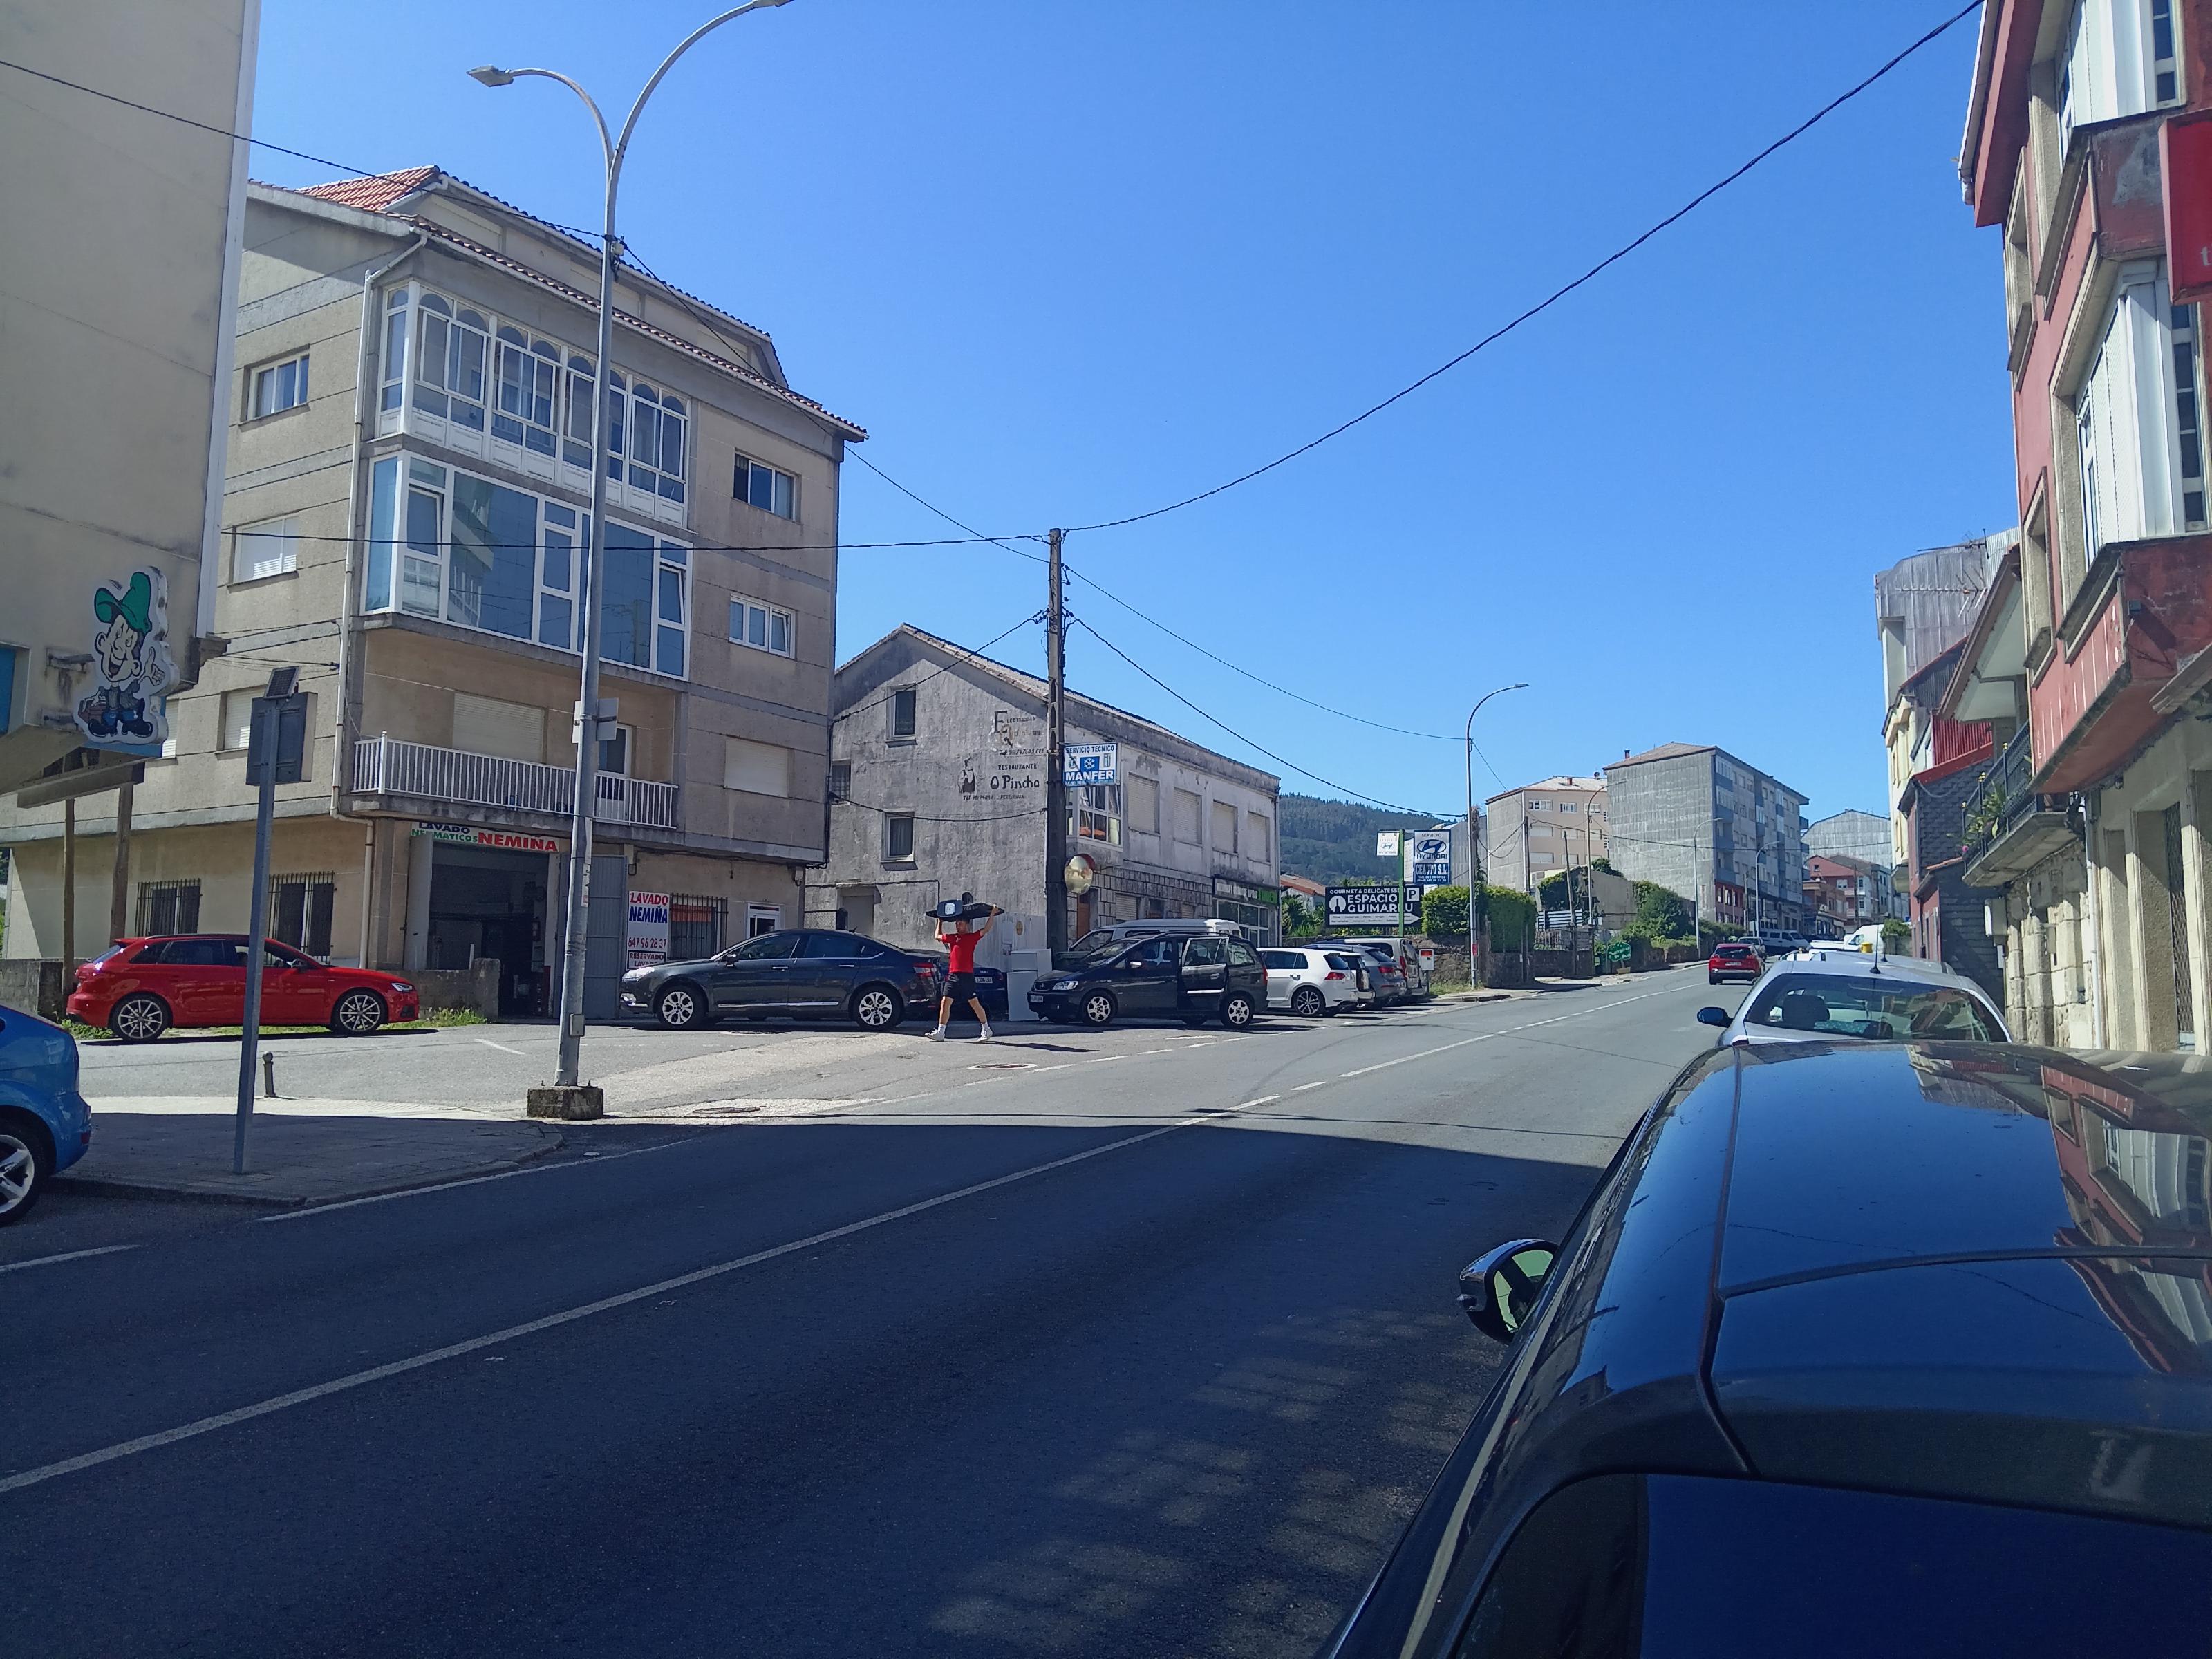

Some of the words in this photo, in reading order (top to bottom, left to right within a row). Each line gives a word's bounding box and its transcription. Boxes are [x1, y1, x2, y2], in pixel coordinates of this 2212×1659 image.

[990, 775, 1000, 789] O
[1002, 775, 1040, 789] Pincho
[1065, 770, 1114, 781] MANFER
[418, 821, 470, 834] LAVADO
[411, 829, 478, 843] NEMATICOS
[478, 832, 559, 852] NEMIÑA
[630, 892, 668, 906] LAVADO
[1347, 894, 1398, 903] ESPACIO
[1409, 889, 1416, 899] P
[629, 906, 668, 924] NEMIÑA
[628, 937, 639, 948] 647
[641, 937, 649, 948] 96
[650, 937, 657, 948] 28
[659, 939, 667, 949] 37
[630, 953, 664, 961] RESERVADO
